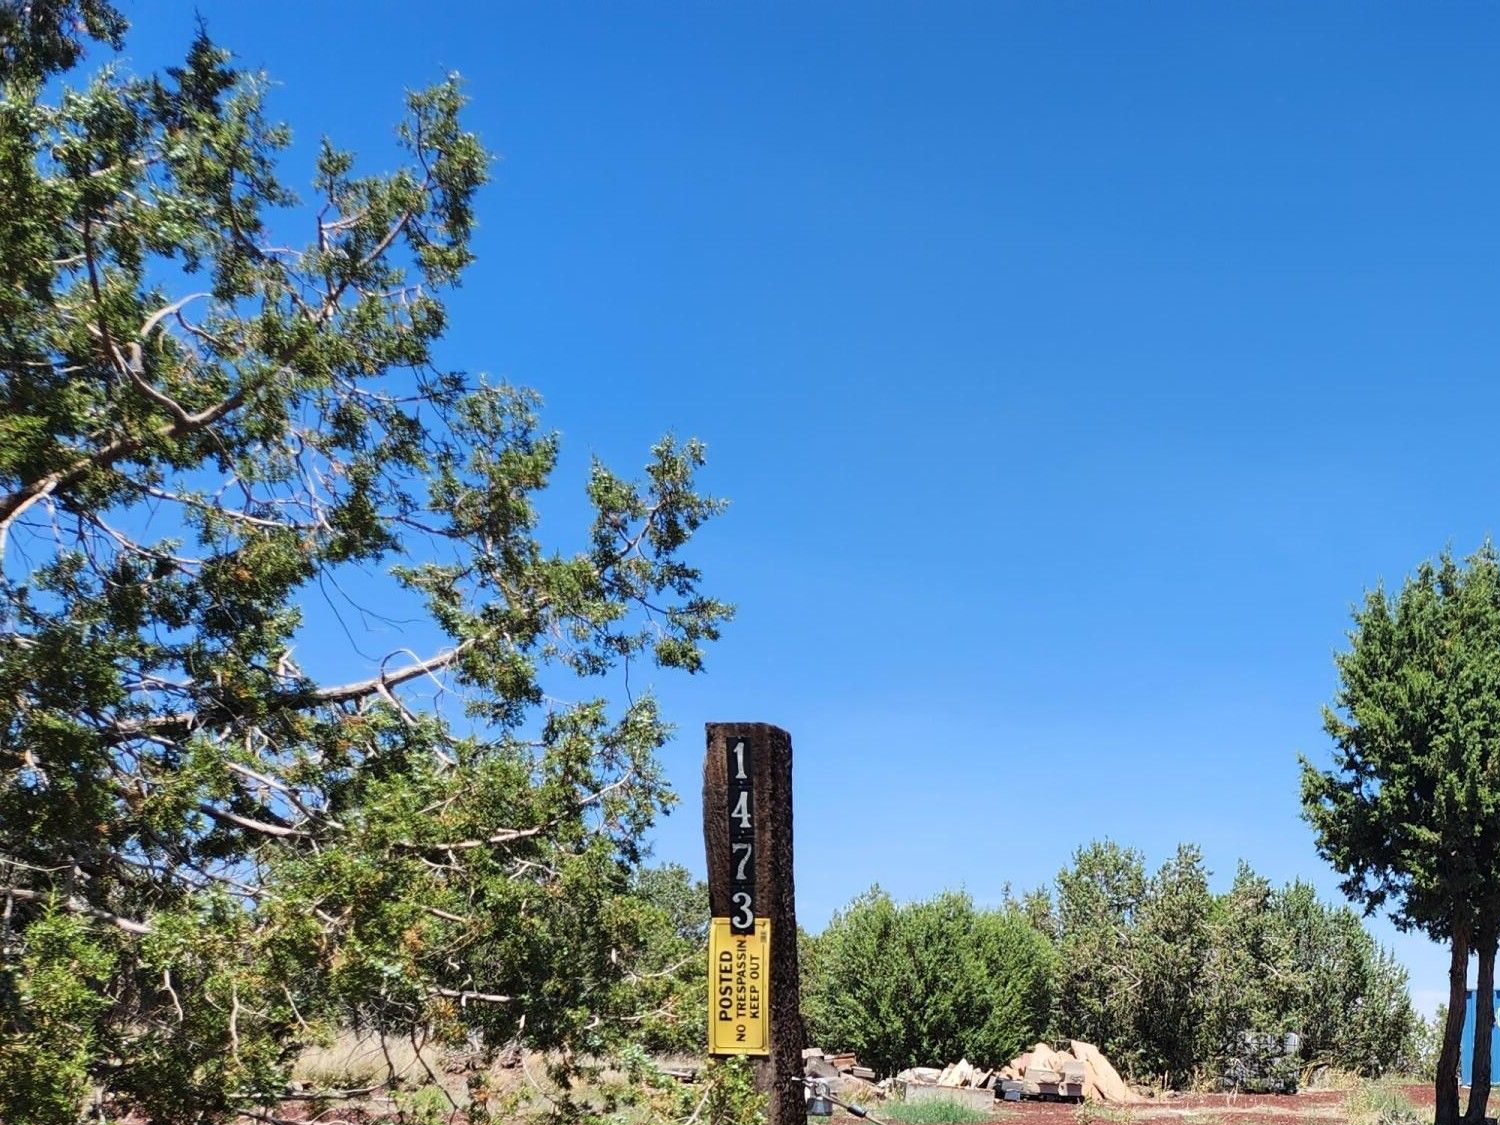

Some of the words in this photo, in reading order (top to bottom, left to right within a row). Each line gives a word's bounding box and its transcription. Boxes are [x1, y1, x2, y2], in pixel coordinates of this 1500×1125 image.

[730, 741, 755, 930] 1473
[719, 950, 733, 1022] POSTED
[736, 937, 747, 1018] TRESPASSIN
[750, 954, 760, 980] OUT
[750, 985, 760, 1019] KEEP
[736, 1024, 747, 1042] NO
